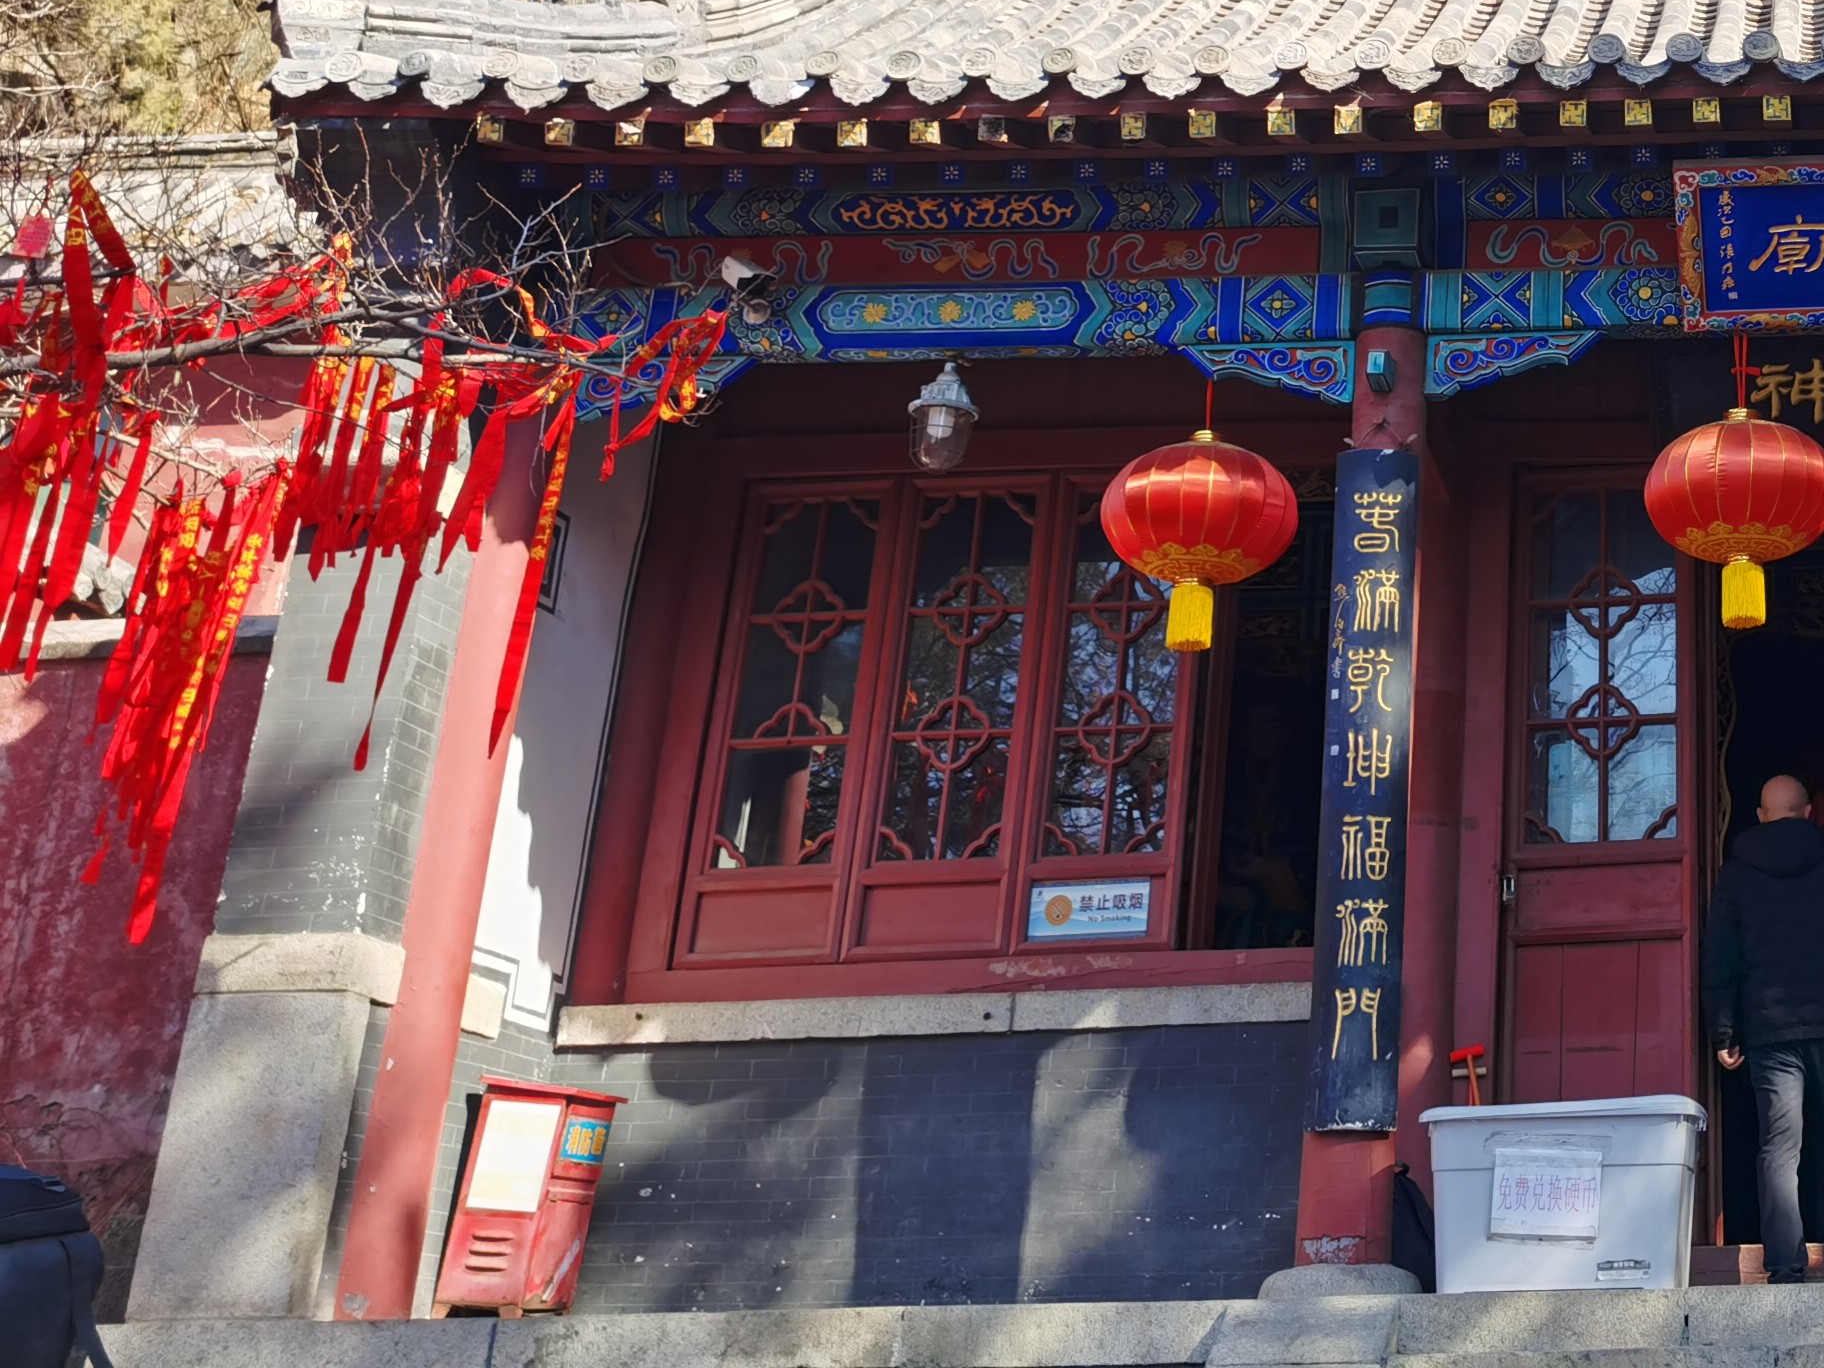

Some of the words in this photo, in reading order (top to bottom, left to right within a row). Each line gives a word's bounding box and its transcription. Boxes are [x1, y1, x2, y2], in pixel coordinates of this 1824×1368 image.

[1079, 892, 1144, 913] 禁止吸烟
[1087, 915, 1099, 923] No
[1101, 913, 1132, 923] Smoking
[1496, 1172, 1597, 1214] 免费兑换硬币
